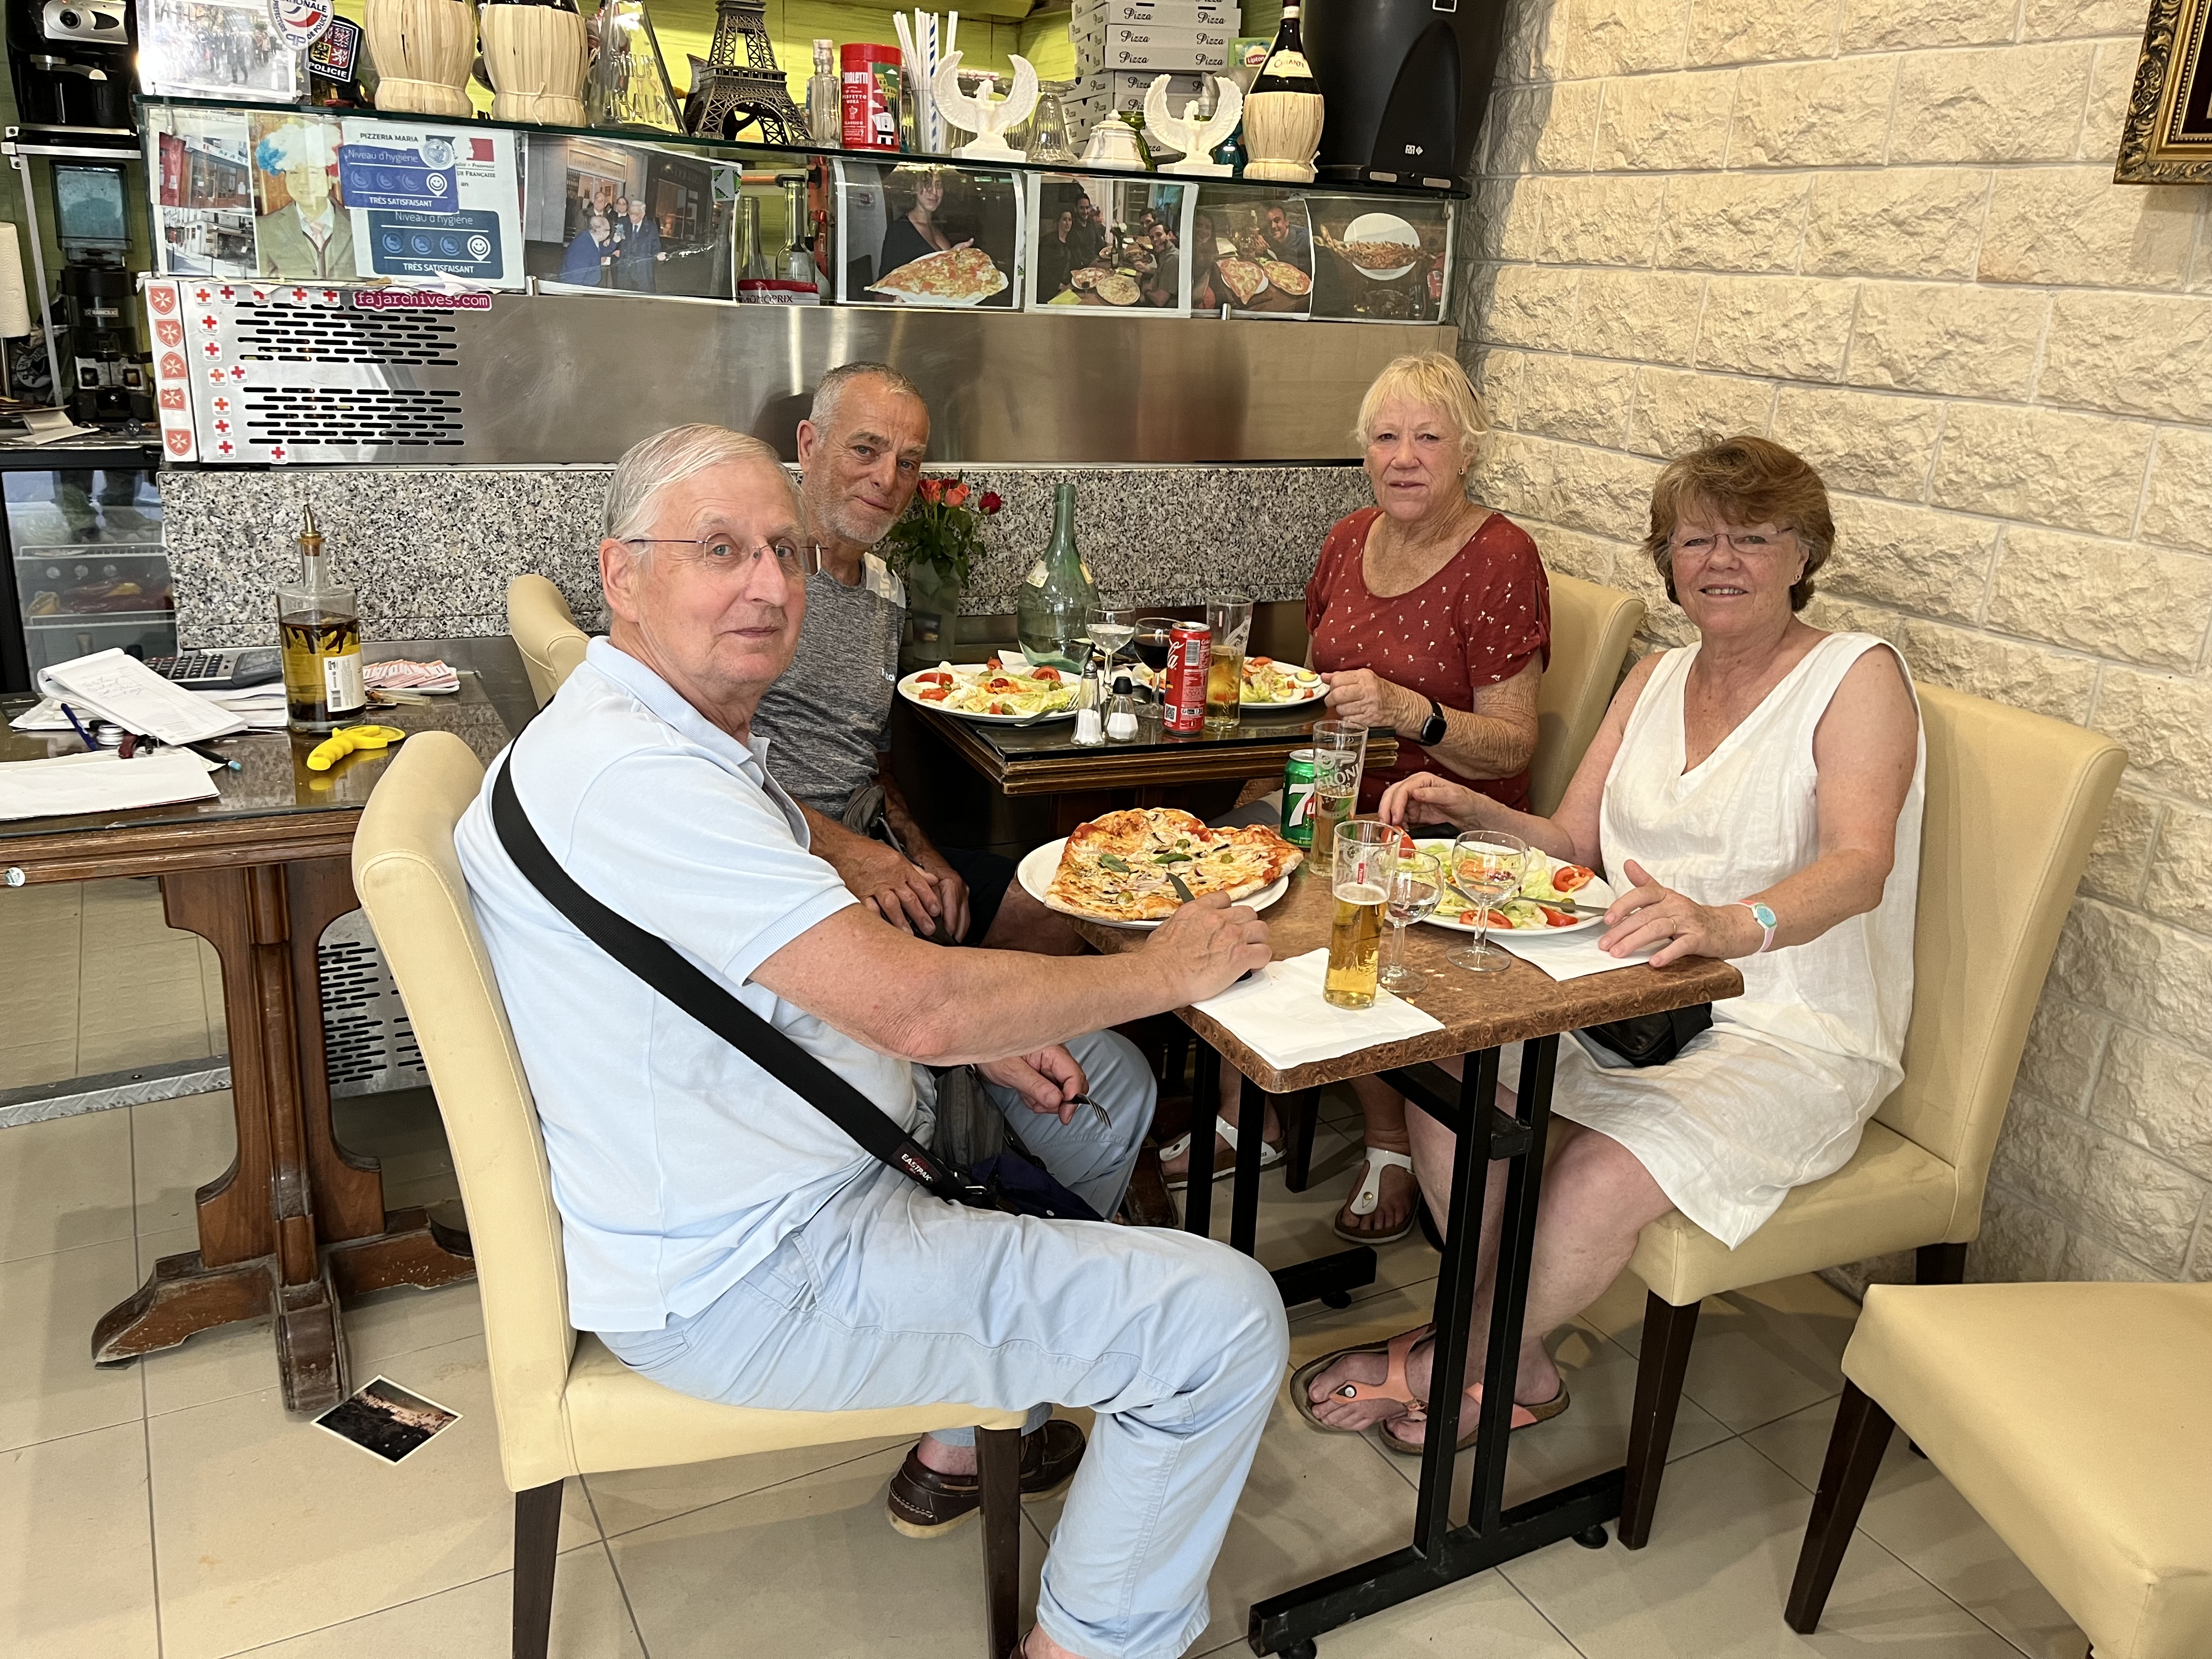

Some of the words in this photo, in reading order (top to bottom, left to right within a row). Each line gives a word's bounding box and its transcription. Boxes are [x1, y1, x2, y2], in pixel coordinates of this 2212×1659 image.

[1124, 7, 1153, 20] Pizza
[1198, 12, 1226, 24] Pizza
[313, 14, 328, 33] POLICE
[1121, 30, 1150, 43] Pizza
[1196, 32, 1226, 45] Pizza
[1119, 51, 1149, 64] Pizza
[1195, 53, 1224, 66] Pizza
[309, 61, 348, 78] POLICIE
[360, 132, 394, 141] PIZZERIA
[347, 149, 377, 159] Niveau
[369, 196, 386, 204] TRÈS
[387, 198, 432, 207] SATISFAISANT
[394, 211, 427, 222] Niveau
[403, 262, 422, 271] TRÈS
[424, 264, 474, 274] SATISFAISANT
[357, 294, 488, 307] fajarchives.com
[1317, 763, 1359, 787] ERONI
[1288, 783, 1315, 827] 7u
[901, 1153, 932, 1181] EASTPAK
